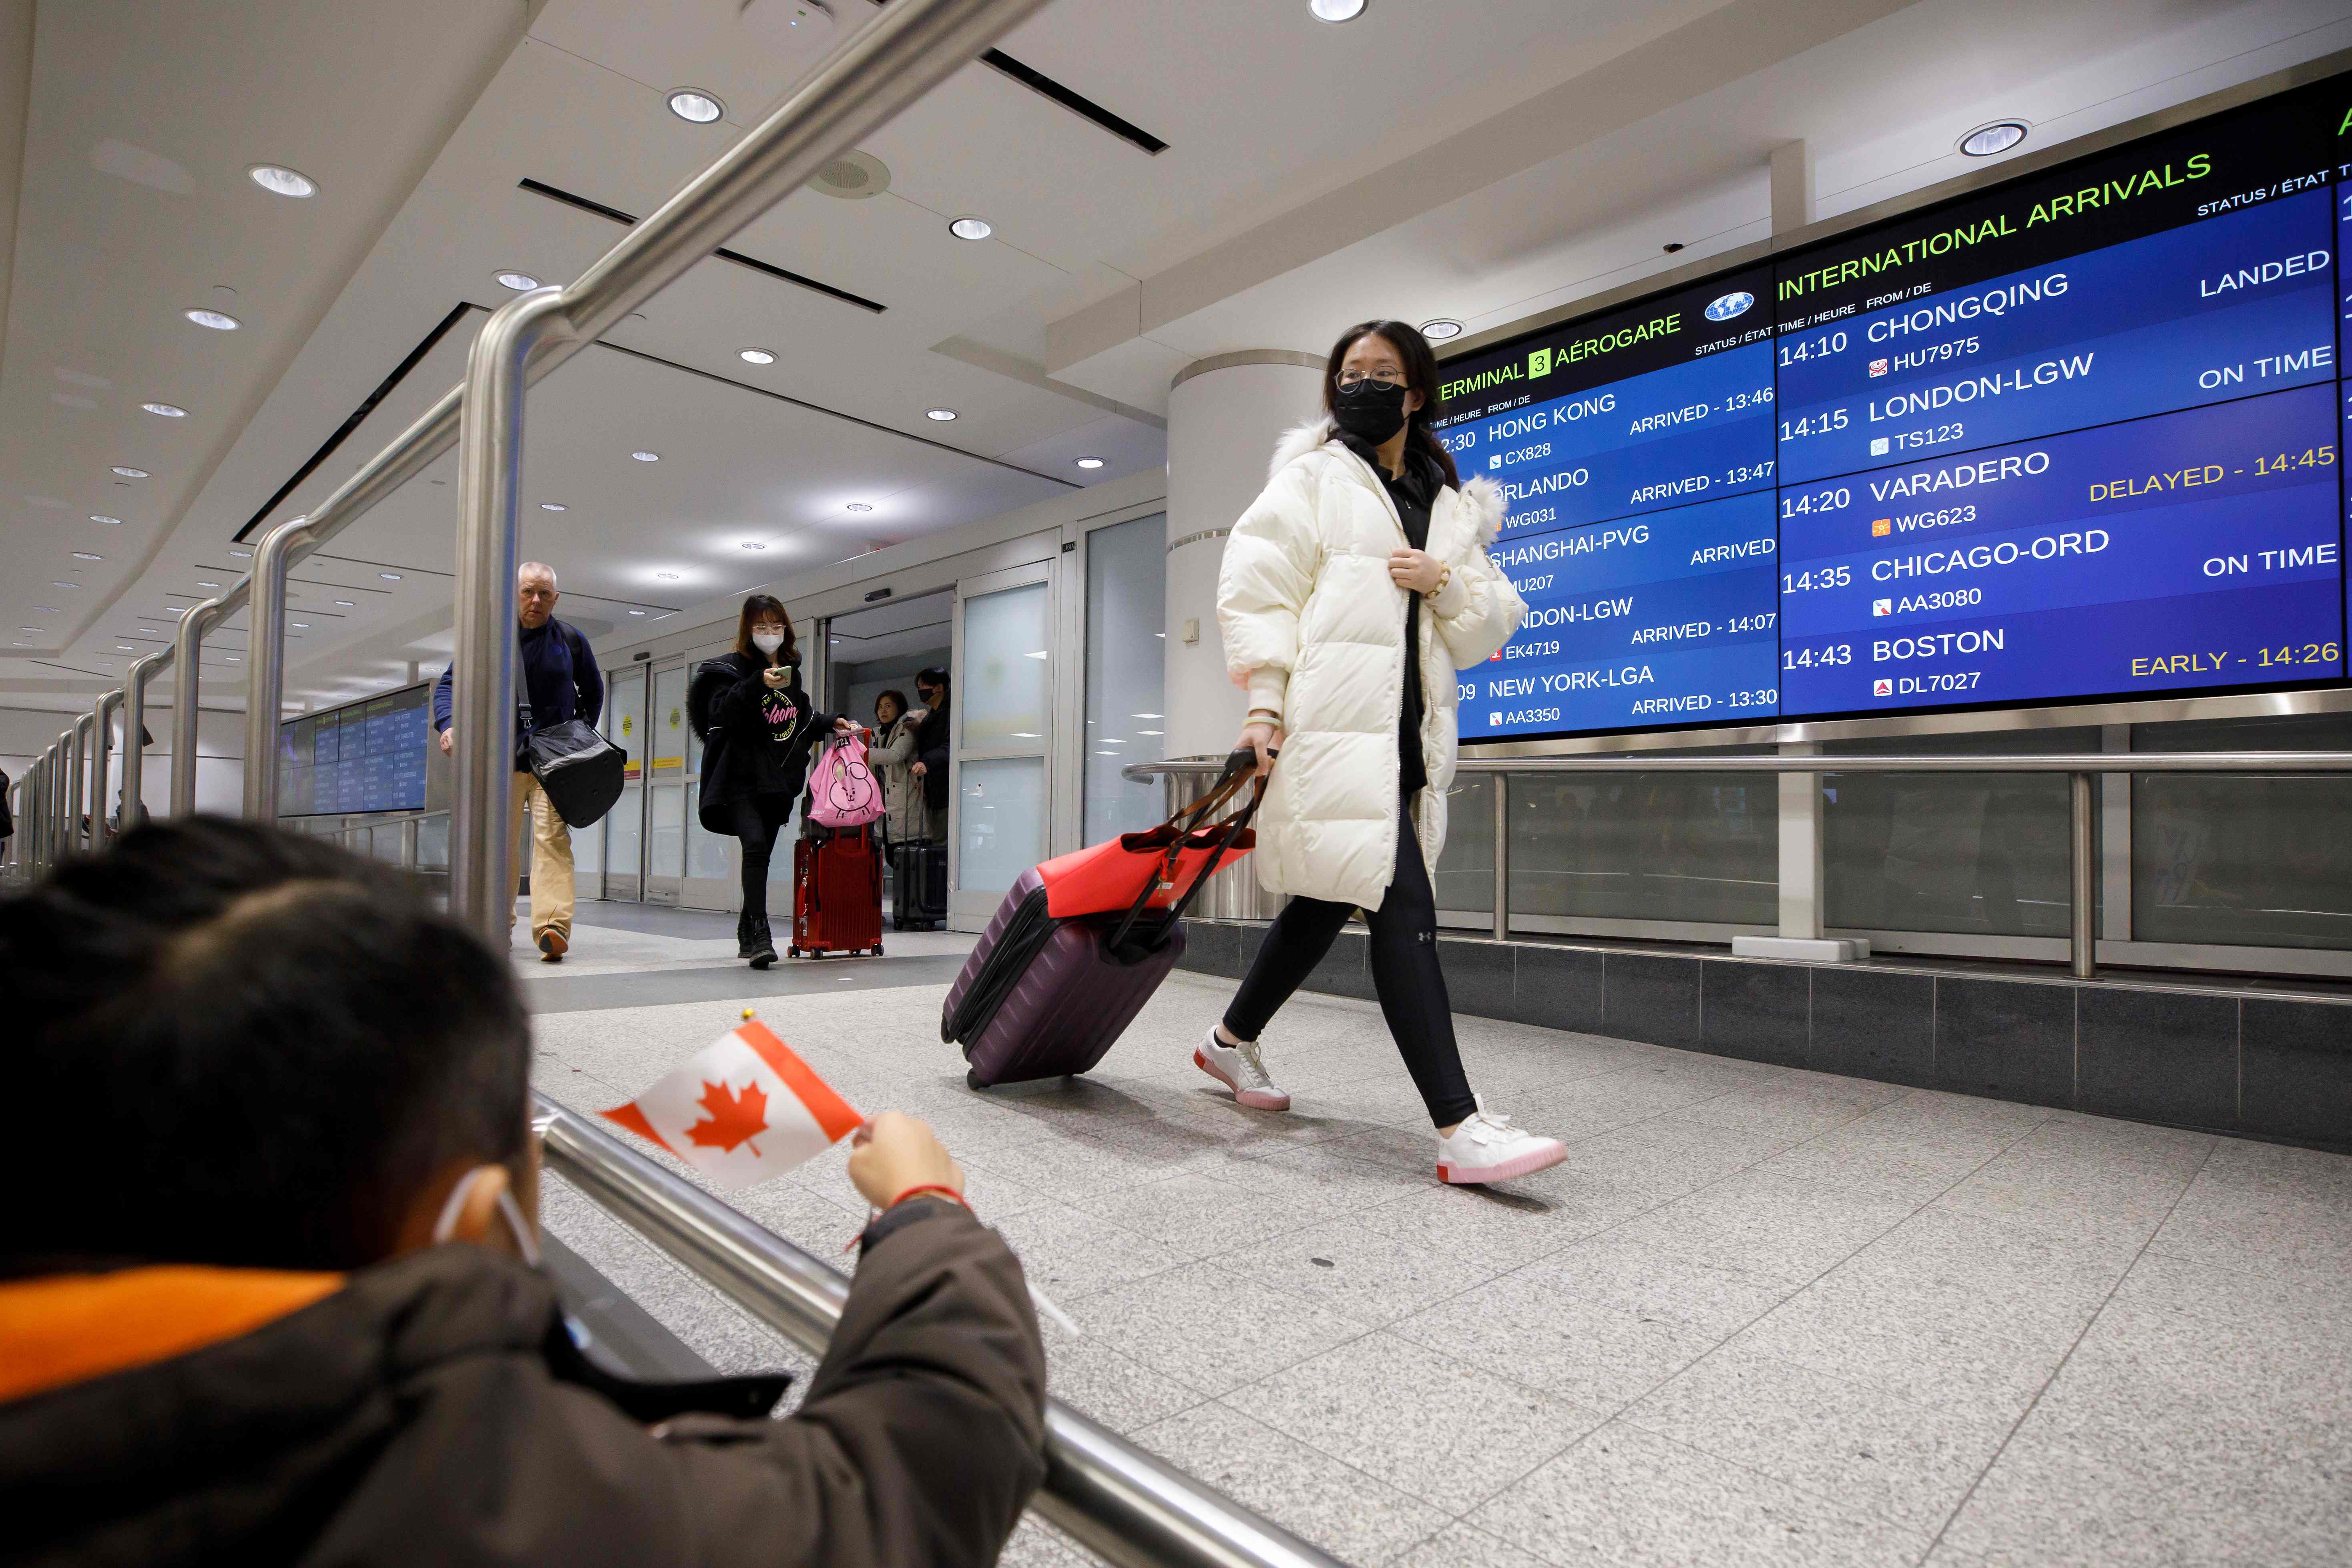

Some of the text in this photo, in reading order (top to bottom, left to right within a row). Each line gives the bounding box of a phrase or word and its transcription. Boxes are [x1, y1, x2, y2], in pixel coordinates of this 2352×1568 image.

[2198, 189, 2266, 215] STATUS
[2272, 185, 2276, 196] /
[2283, 170, 2328, 192] ÉTAT
[1779, 154, 2210, 301] INTERNATIONAL ARRIVALS
[2201, 251, 2329, 297] LANDED
[1867, 283, 1931, 308] FROM / DE
[1778, 304, 1855, 332] TIME / HEURE
[1780, 274, 2067, 366] 14:10 CHONGQING
[1437, 313, 1680, 401] ERMINAL 3 AÉROGARE
[1695, 327, 1773, 355] STATUS / ÉTAT
[1895, 336, 1979, 371] HU7975
[2199, 346, 2332, 388] ON TIME
[1488, 400, 1511, 413] FROM
[1519, 395, 1530, 405] DE
[1630, 404, 1708, 435] ARRIVED
[1726, 387, 1773, 411] 13:46
[1781, 353, 2094, 441] 14:15 LONDON-LGW
[1441, 394, 1615, 453] 2:30 HONG KONG
[1454, 409, 1481, 423] HEURE
[1895, 423, 1963, 450] TS123
[1506, 443, 1551, 464] CX828
[1631, 476, 1709, 504] ARRIVED
[1727, 461, 1774, 484] 13:47
[1783, 452, 2049, 518] 14:20 VARADERO
[2091, 466, 2223, 501] DELAYED
[2255, 446, 2334, 475] 14:45
[1505, 508, 1556, 528] WG031
[1896, 506, 1976, 532] WG623
[1490, 525, 1649, 568] SHANGHAI-PVG
[1691, 539, 1775, 565] ARRIVED
[1783, 530, 2109, 593] 14:35 CHICAGO-ORD
[2204, 544, 2336, 576] ON TIME
[1516, 597, 1633, 630] NDON-LGW
[1897, 588, 1981, 613] AA3080
[1631, 622, 1710, 644] ARRIVED
[1729, 613, 1776, 632] 14:07
[1506, 641, 1559, 659] EK4719
[1784, 629, 2003, 669] 14:43 BOSTON
[2133, 652, 2227, 676] EARLY
[2259, 643, 2338, 666] 14:26
[1490, 677, 1535, 697] NEW
[1541, 666, 1654, 692] YORK-LGA
[1900, 672, 1980, 693] DL7027
[1506, 708, 1560, 724] AA3350
[1632, 695, 1711, 714] ARRIVED
[1729, 689, 1777, 707] 13:30
[779, 720, 795, 739] FOREVER
